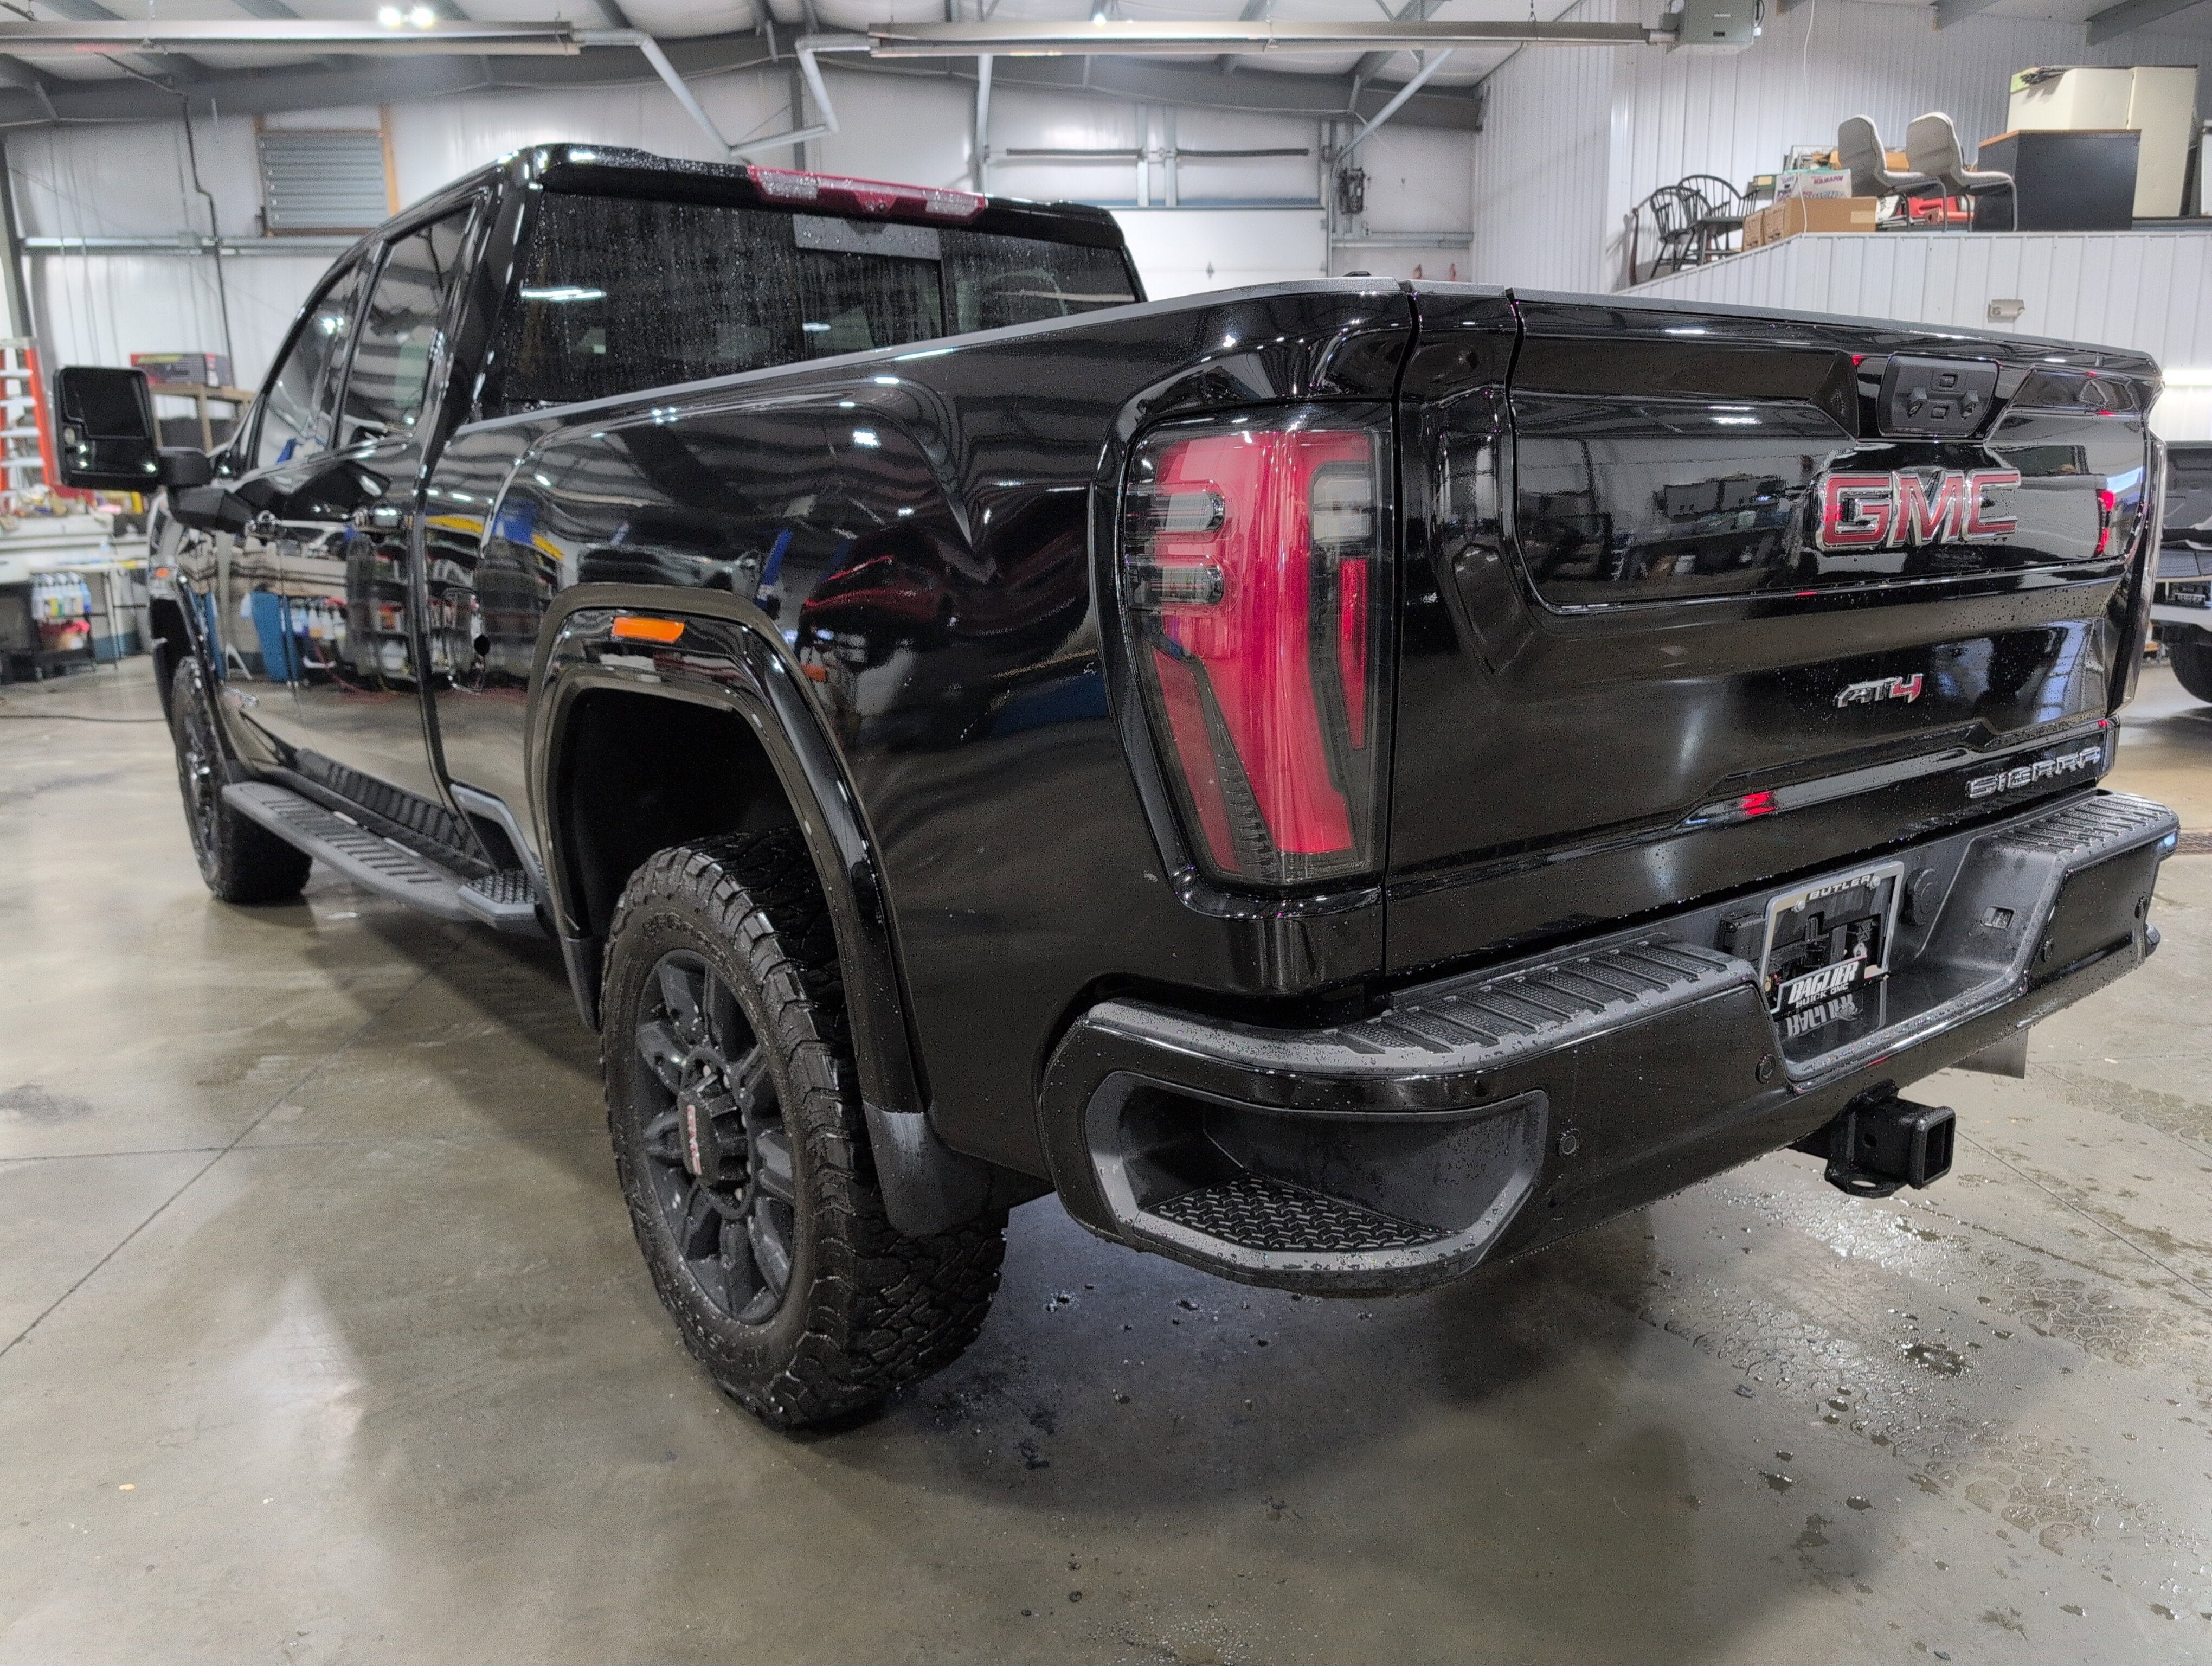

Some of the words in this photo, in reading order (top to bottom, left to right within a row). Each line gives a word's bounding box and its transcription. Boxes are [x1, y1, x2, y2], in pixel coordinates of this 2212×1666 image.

[1815, 468, 2021, 551] GMC
[1836, 673, 1924, 708] AT4
[1967, 746, 2101, 799] SIERRA
[1809, 875, 1870, 900] BUTLER
[1789, 961, 1859, 1004] BAGLIER
[1796, 991, 1827, 1009] BUICK
[1830, 983, 1849, 994] GMC
